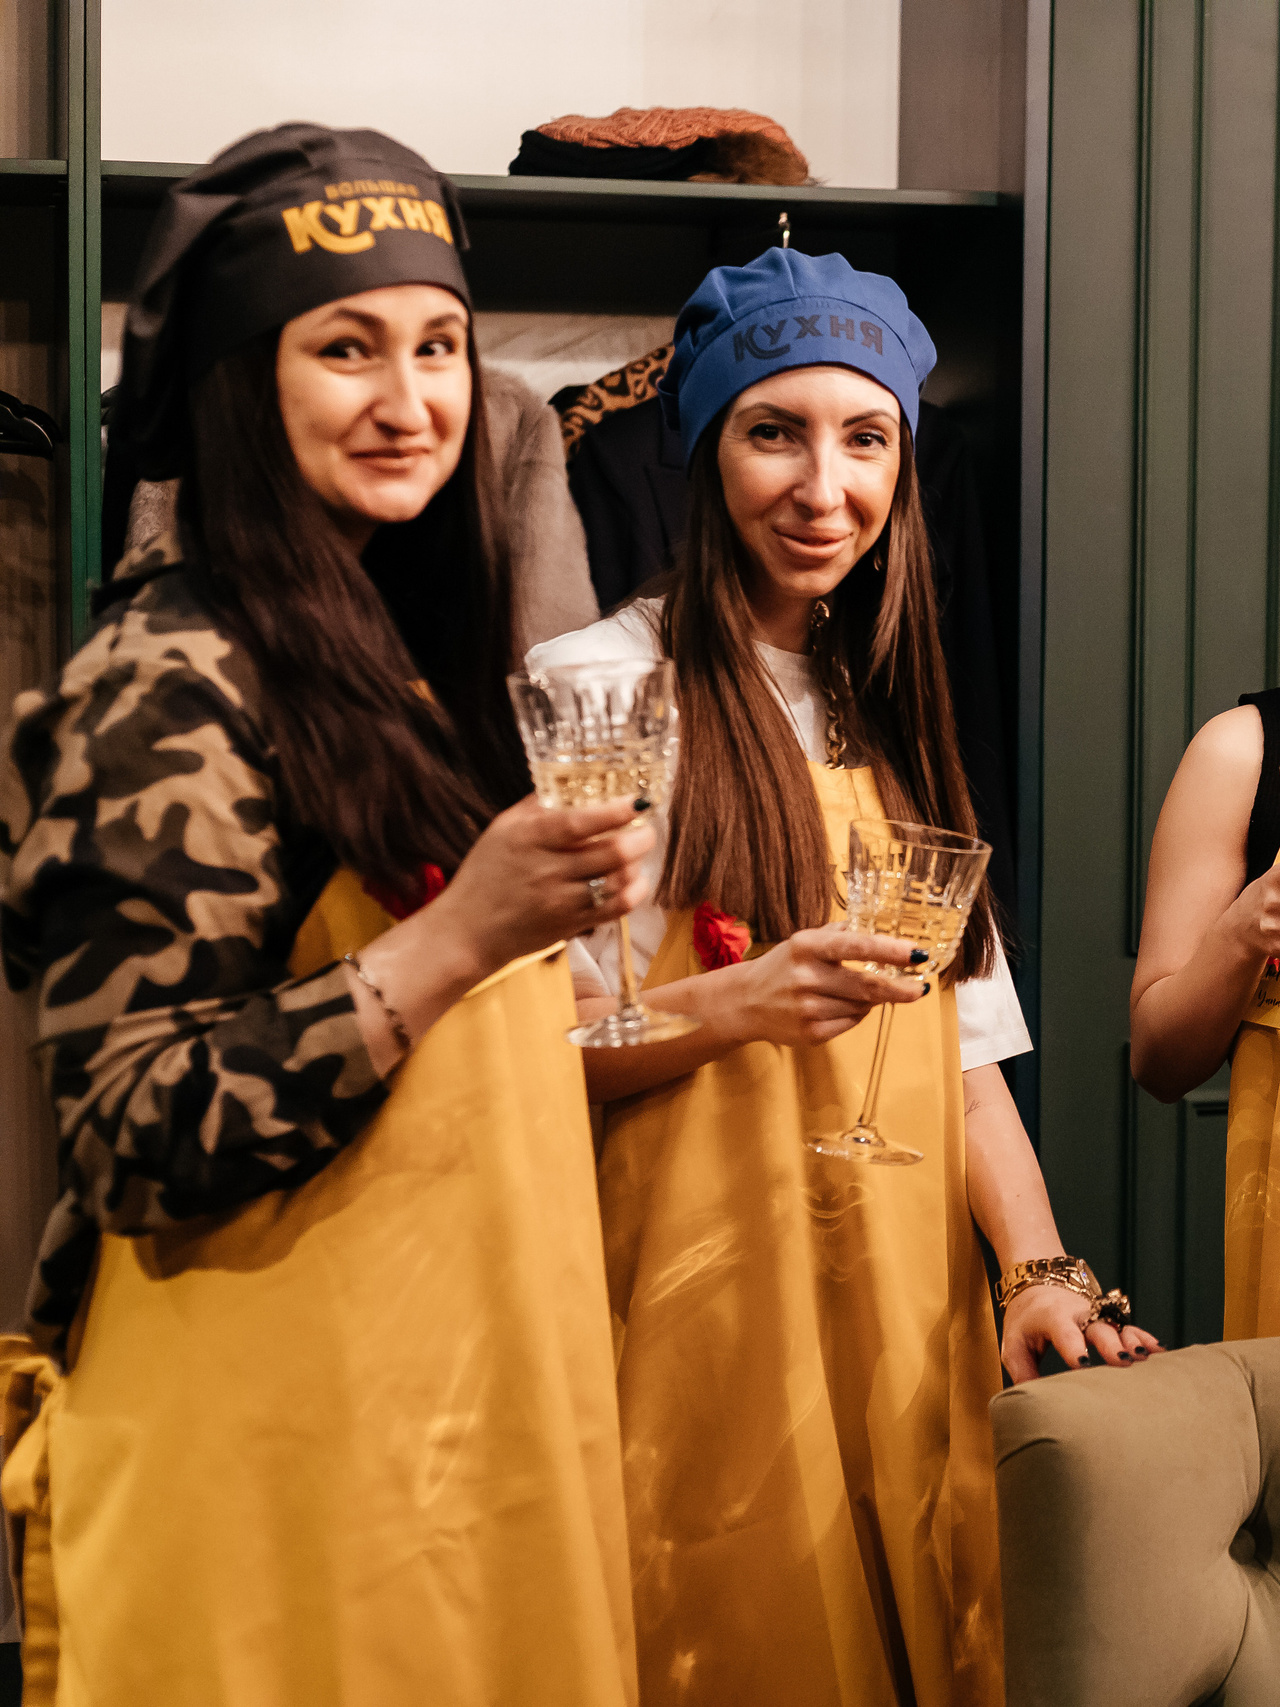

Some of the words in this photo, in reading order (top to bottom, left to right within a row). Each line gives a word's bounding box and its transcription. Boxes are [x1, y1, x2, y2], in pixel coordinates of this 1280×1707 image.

[281, 196, 454, 255] КУХНЯ
[732, 313, 884, 363] КУХНЯ
[1257, 988, 1280, 1007] Yana
